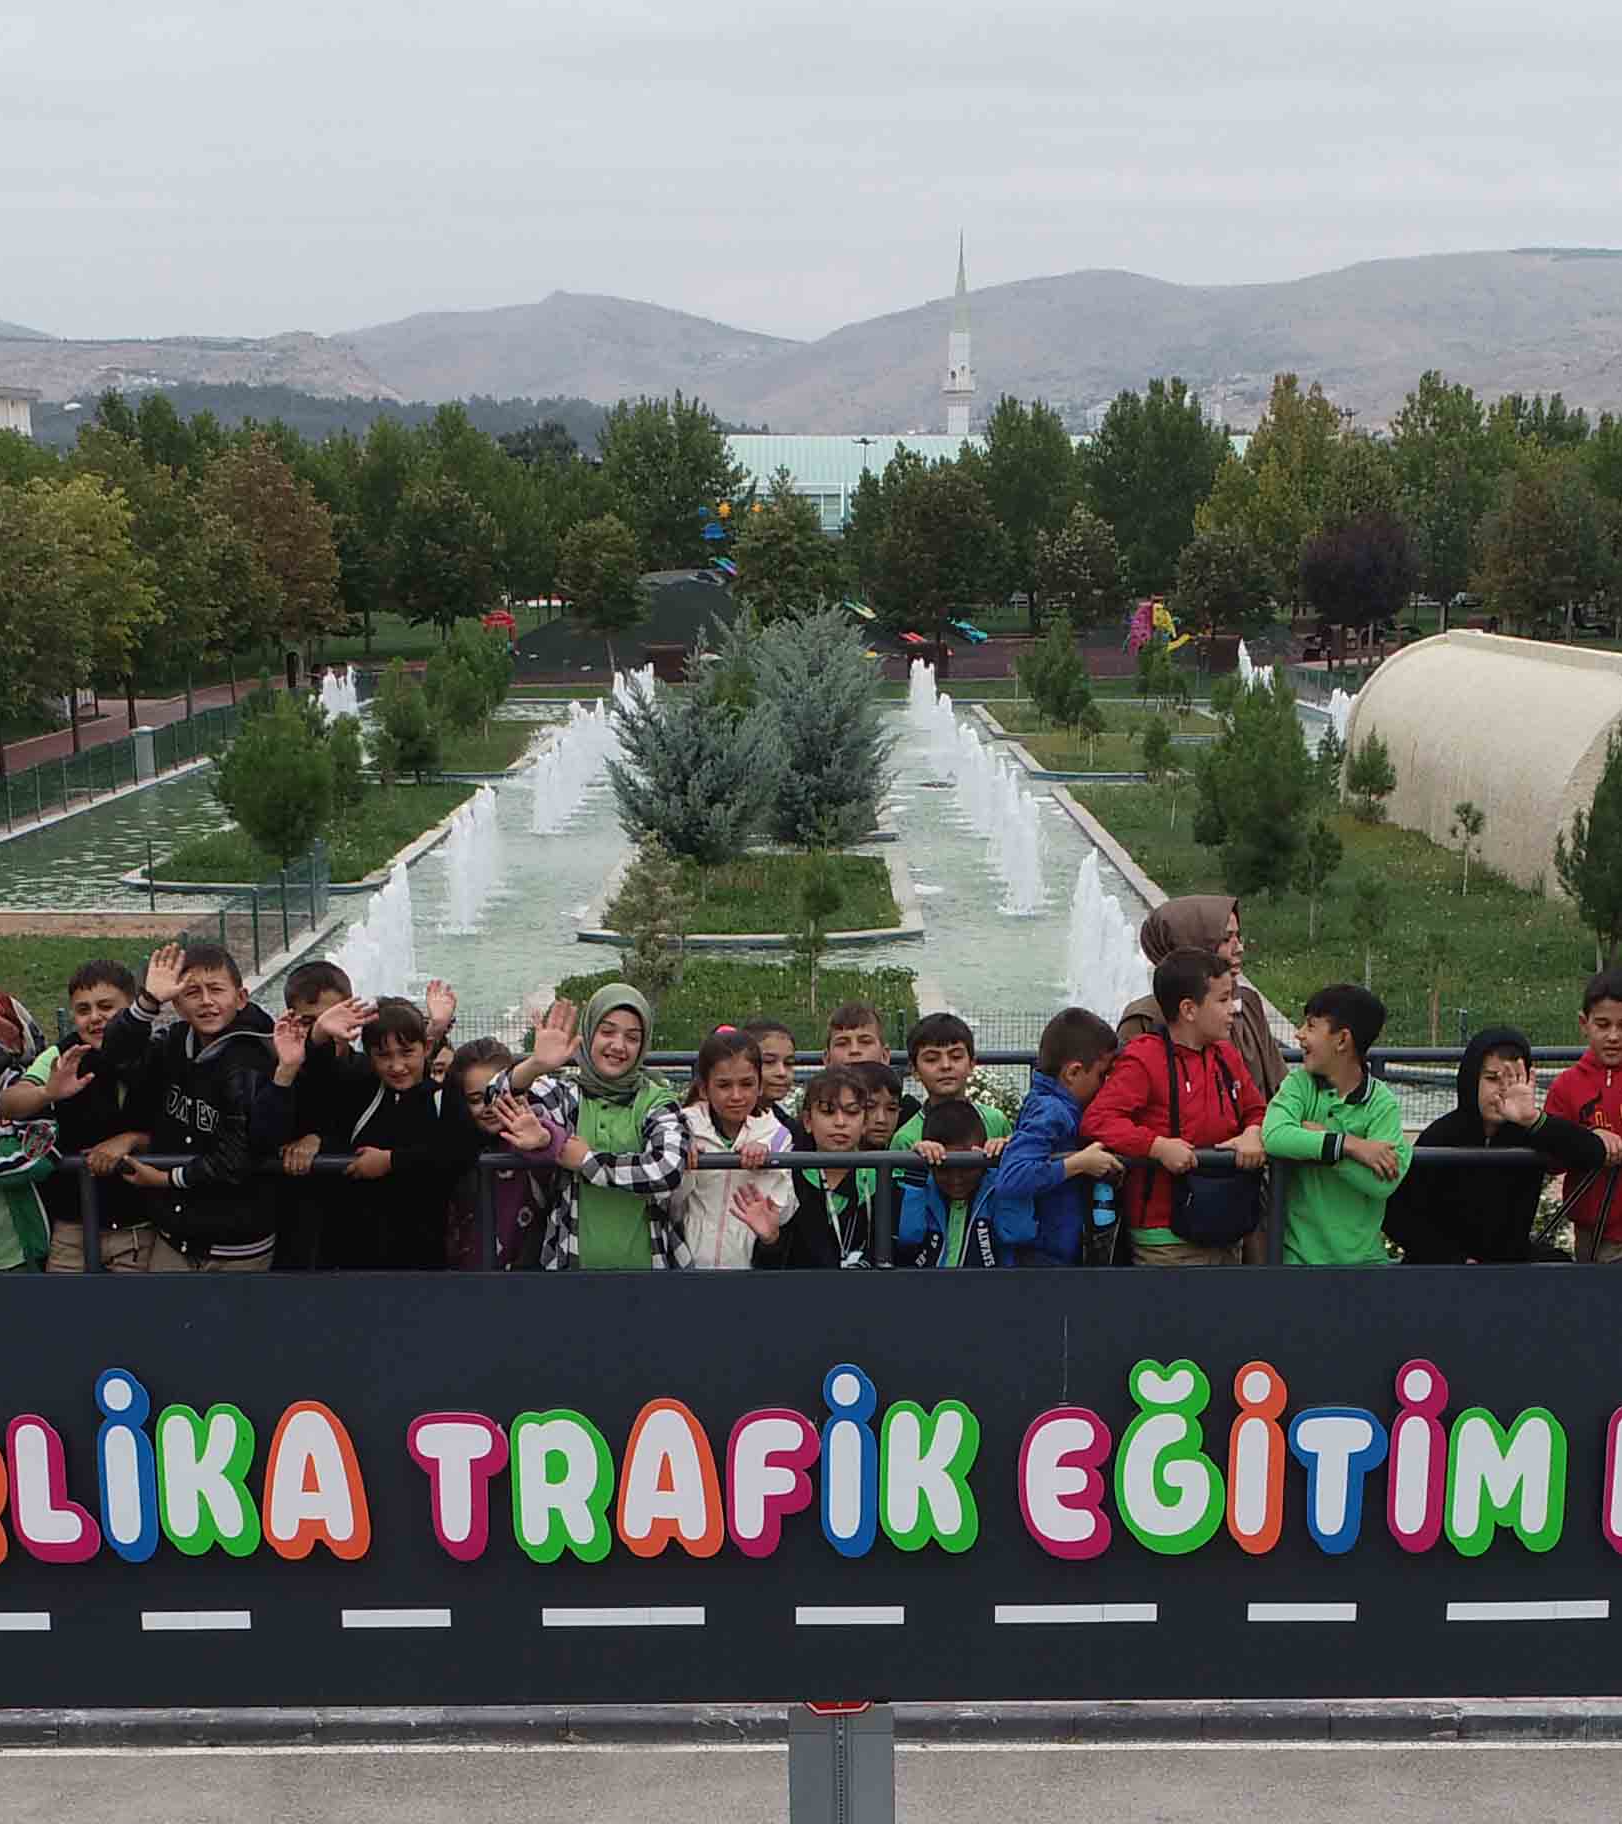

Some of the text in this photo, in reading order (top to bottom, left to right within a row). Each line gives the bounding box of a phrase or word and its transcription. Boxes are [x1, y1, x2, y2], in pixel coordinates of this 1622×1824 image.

[977, 1227, 996, 1268] ALWAYS
[407, 1363, 980, 1563] TRAFİK
[1018, 1358, 1567, 1560] EĞİTİM
